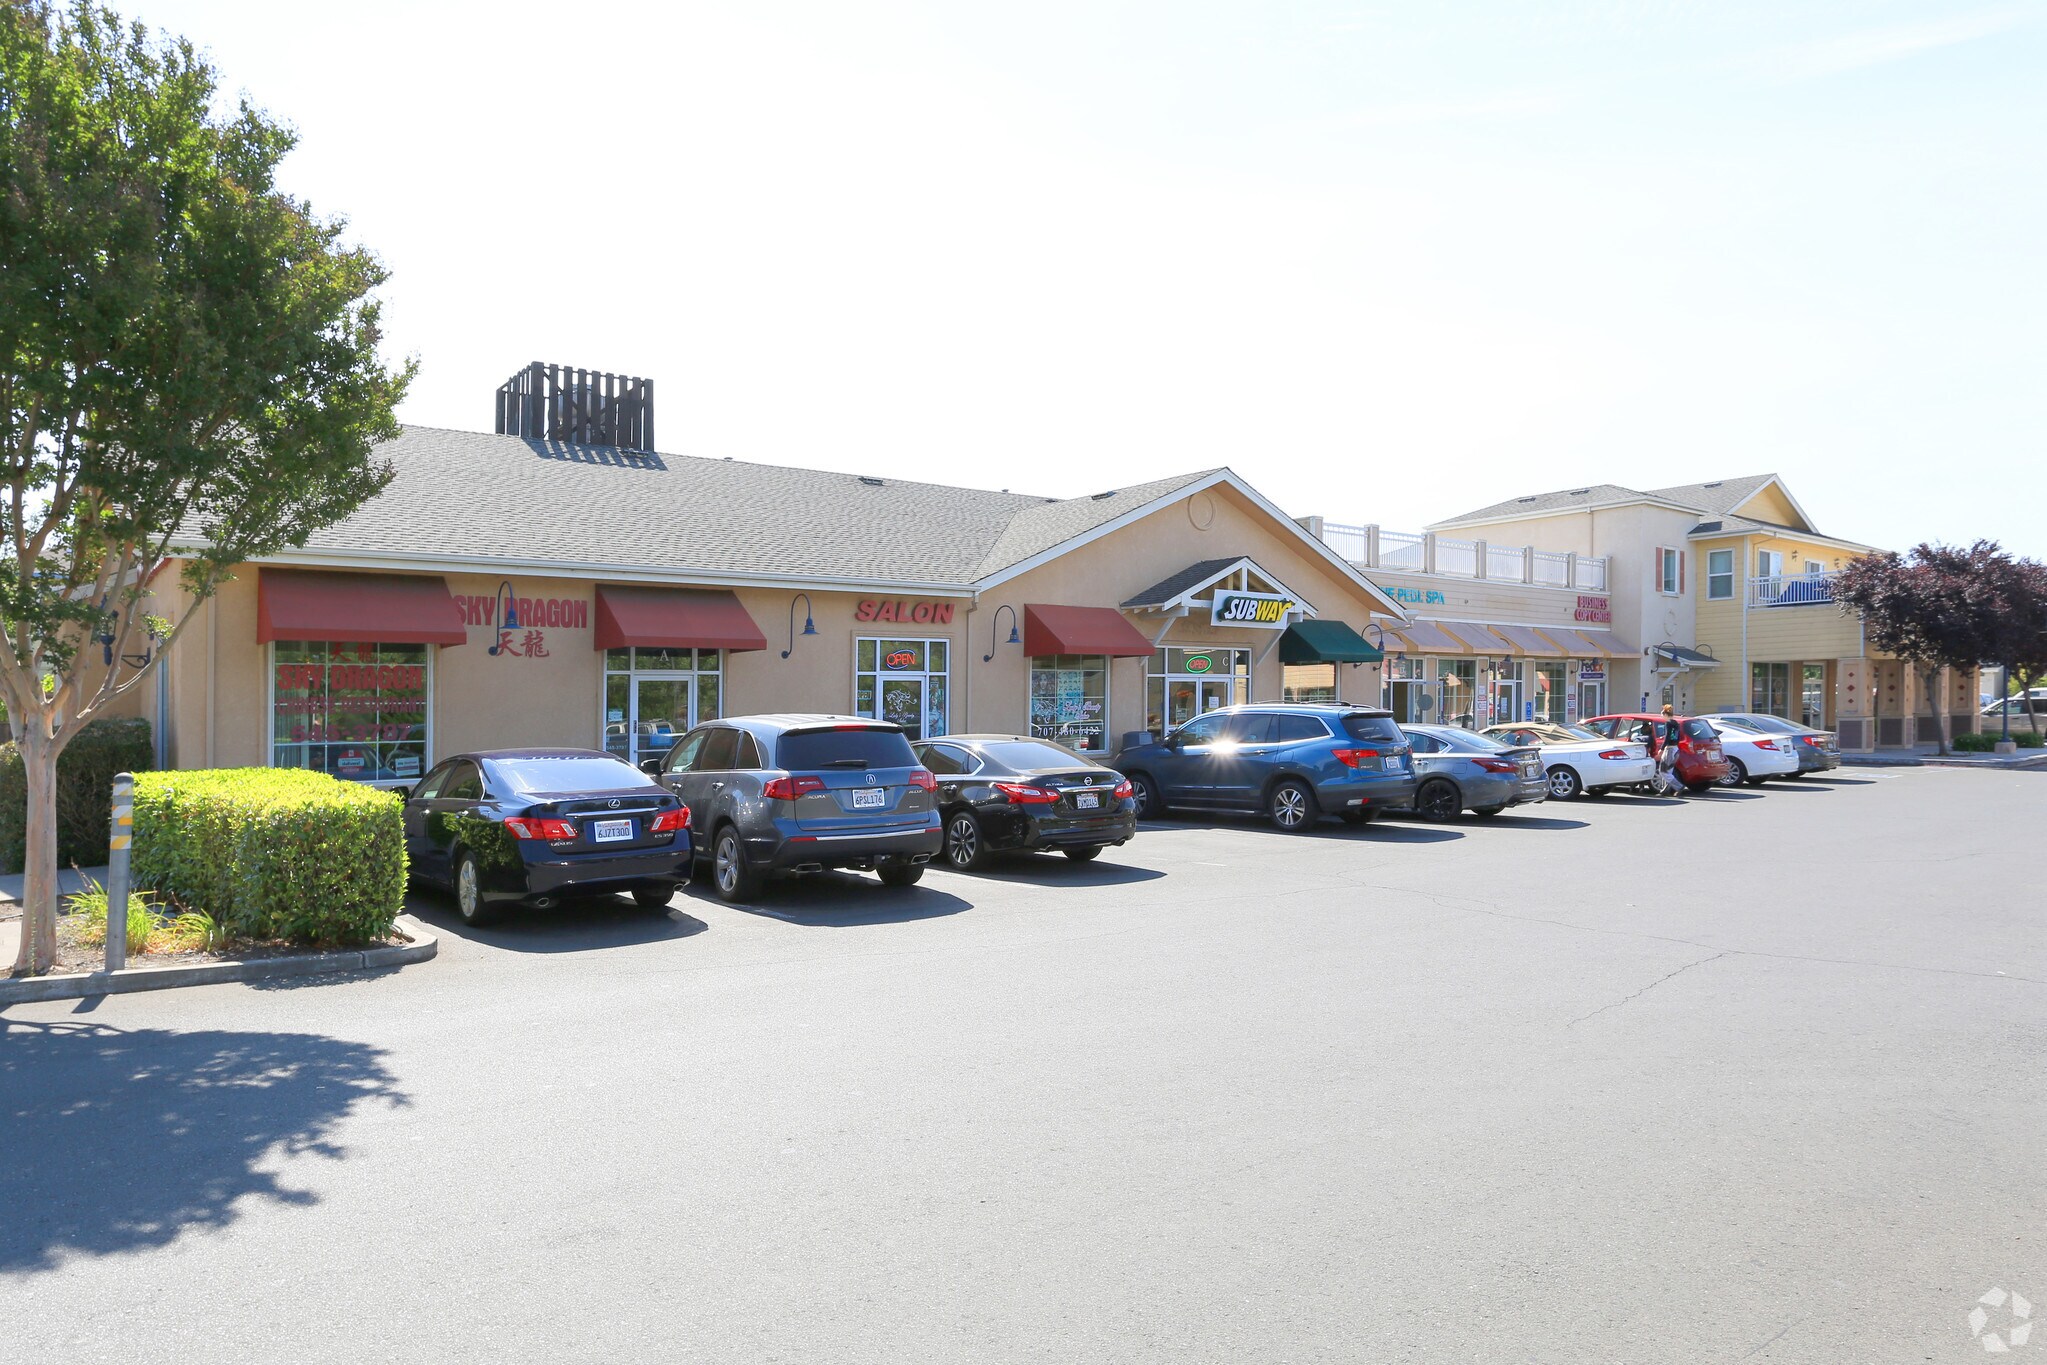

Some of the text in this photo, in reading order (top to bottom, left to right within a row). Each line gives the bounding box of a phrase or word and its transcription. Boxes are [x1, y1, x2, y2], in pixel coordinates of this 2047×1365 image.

[1426, 591, 1445, 604] SPA
[1577, 596, 1608, 609] BUSINESS
[453, 595, 496, 626] SKY
[854, 599, 956, 624] SALON
[1223, 598, 1293, 622] SUBWAY
[1574, 609, 1611, 623] COPY CENTER
[886, 653, 916, 666] OPEN
[1189, 660, 1208, 669] OPEN
[277, 664, 423, 690] SKY DRAGON
